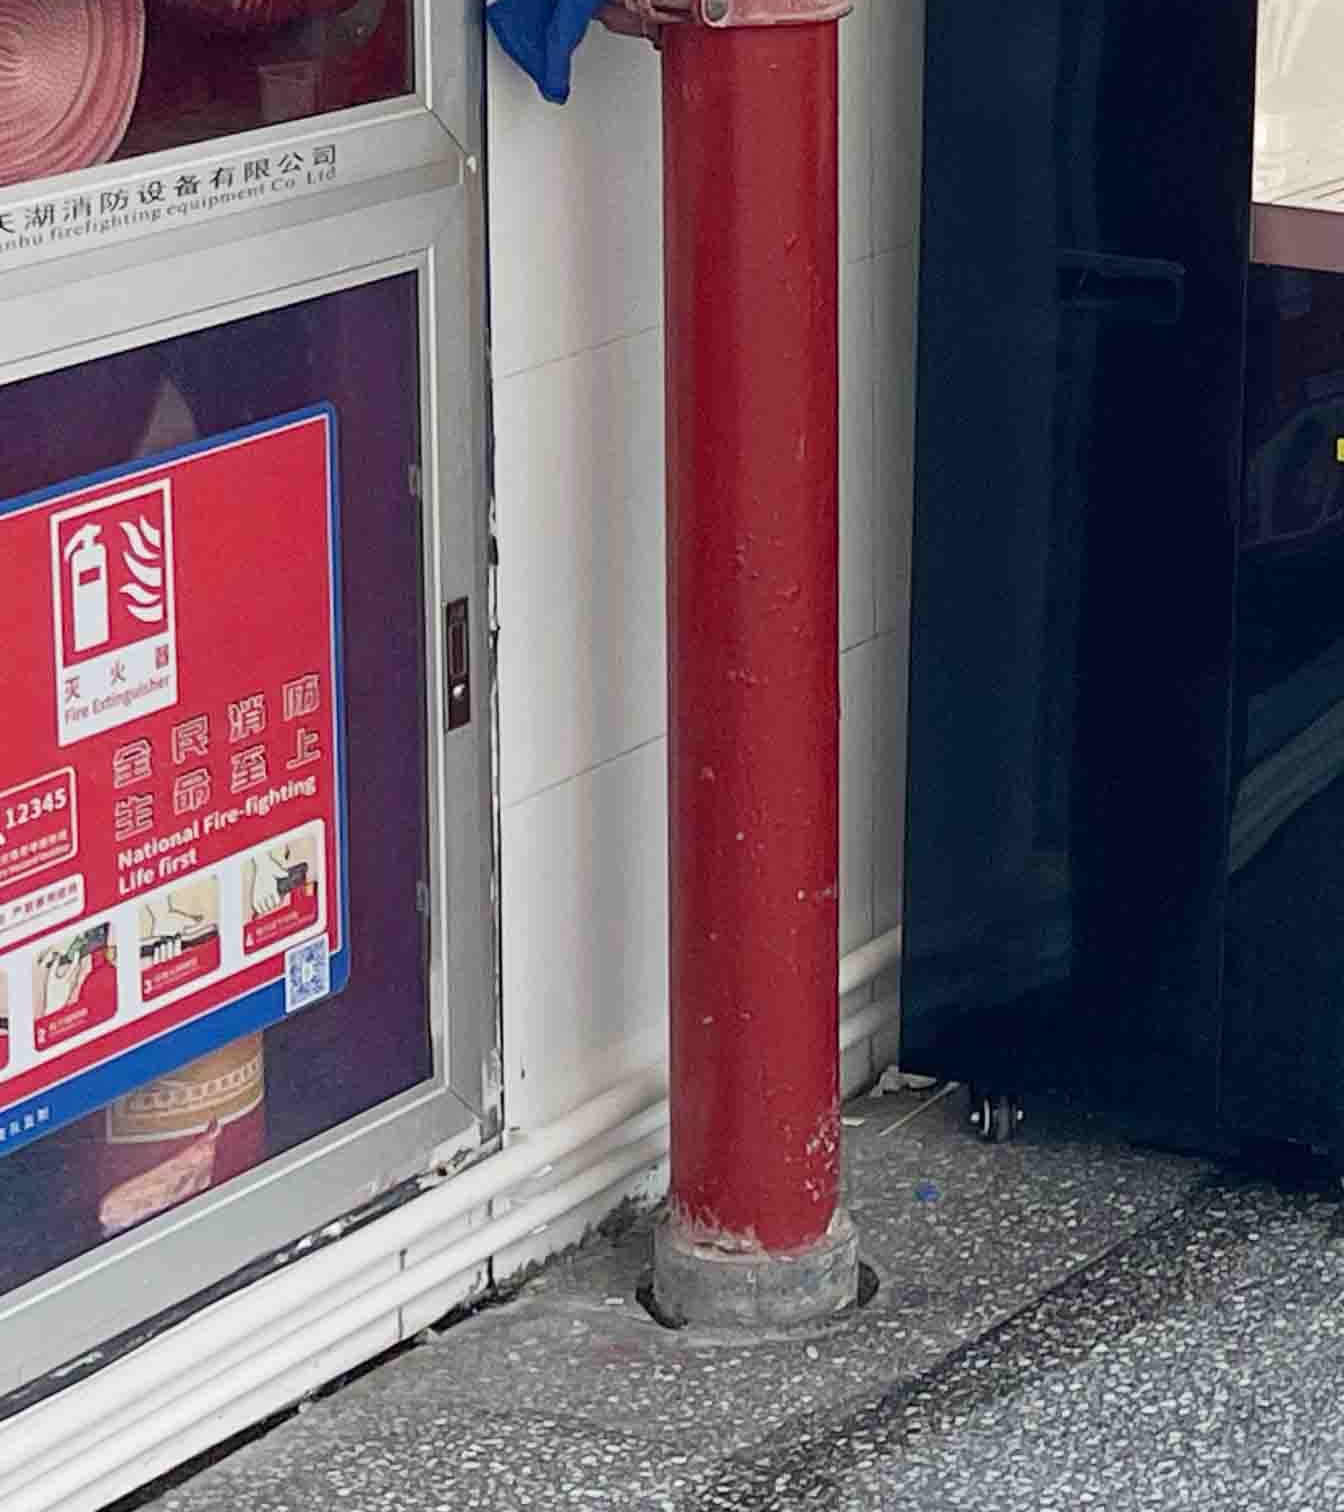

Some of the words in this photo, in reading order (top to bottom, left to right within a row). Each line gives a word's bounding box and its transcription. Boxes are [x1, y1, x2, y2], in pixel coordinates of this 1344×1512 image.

[5, 787, 67, 830] 12345
[118, 820, 200, 871] National
[203, 774, 317, 836] Fire-fighting
[119, 868, 156, 896] Life
[159, 848, 198, 885] first
